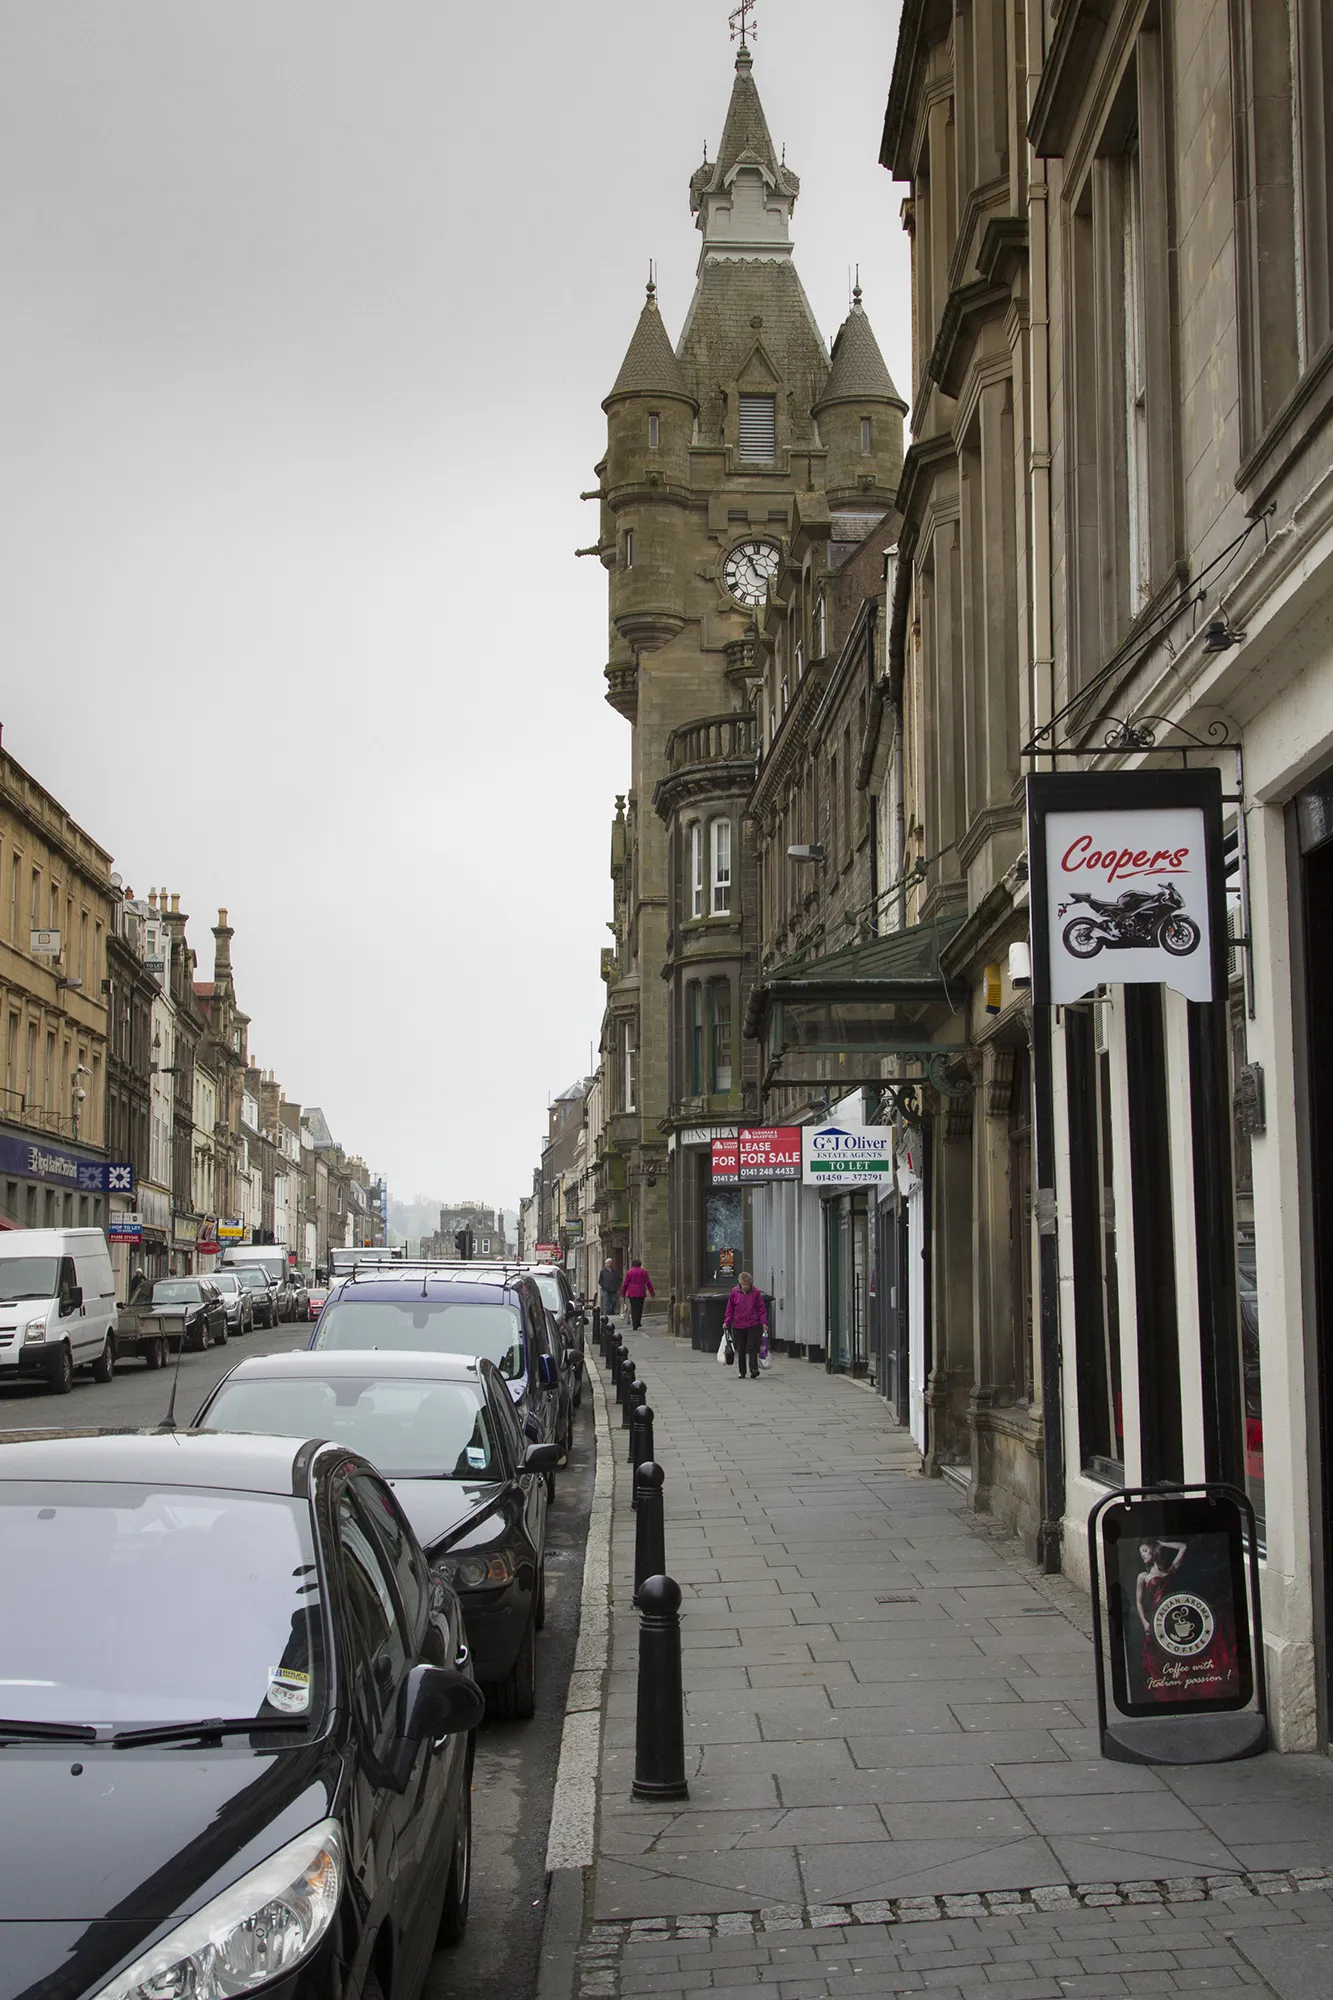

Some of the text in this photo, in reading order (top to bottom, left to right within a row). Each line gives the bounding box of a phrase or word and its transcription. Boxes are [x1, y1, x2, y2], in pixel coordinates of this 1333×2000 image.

[1060, 834, 1190, 884] Coopers
[740, 1142, 771, 1152] LEASE
[844, 1136, 887, 1149] Oliver
[712, 1156, 736, 1167] FOR
[740, 1151, 800, 1164] FOR SALE
[741, 1167, 795, 1176] 0141 248 4433
[829, 1161, 870, 1170] TO LET
[816, 1173, 842, 1181] 01450
[852, 1173, 882, 1181] 372791
[1157, 1597, 1210, 1627] ITALIAN AROMA
[1166, 1638, 1206, 1653] COFFEE
[1162, 1659, 1215, 1679] Coffee with
[1147, 1676, 1183, 1690] Italian
[1184, 1674, 1222, 1689] passion
